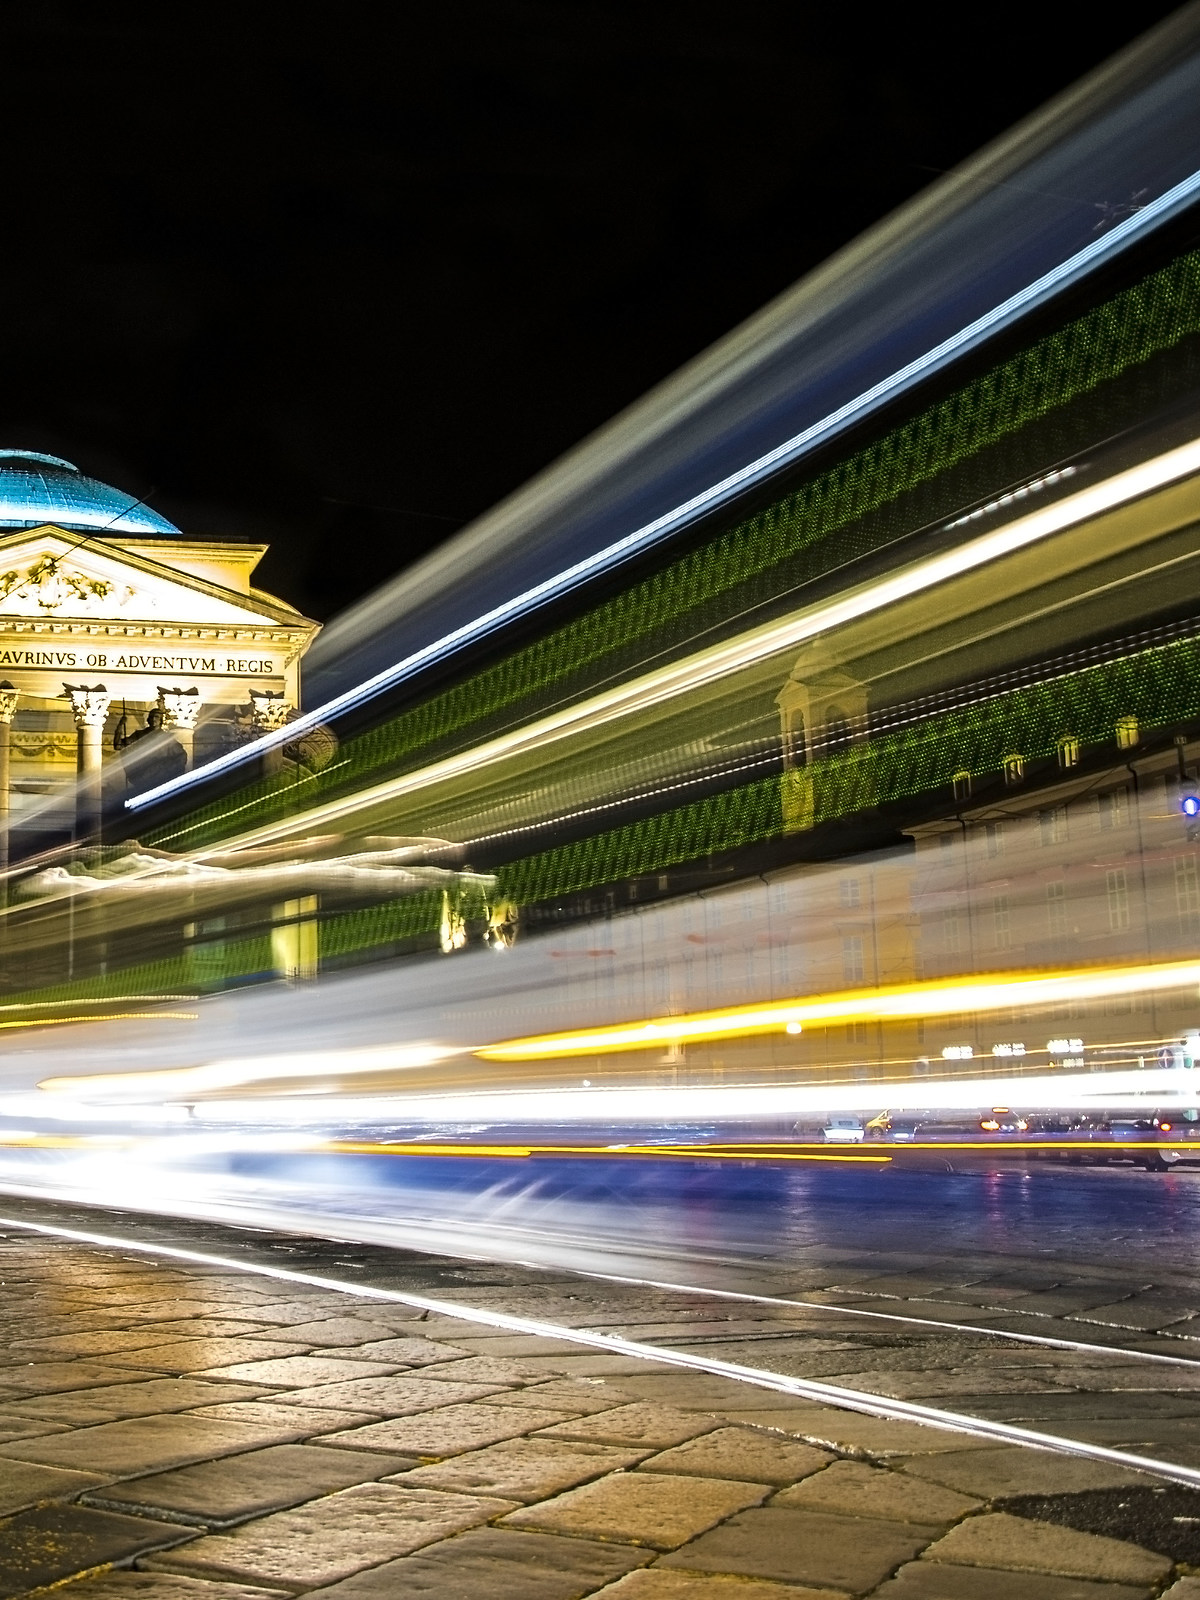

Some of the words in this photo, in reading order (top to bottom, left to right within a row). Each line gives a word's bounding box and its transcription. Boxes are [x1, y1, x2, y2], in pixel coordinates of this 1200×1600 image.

[86, 654, 107, 667] OB
[116, 655, 215, 671] ADVENTVM
[226, 659, 273, 673] REGIS
